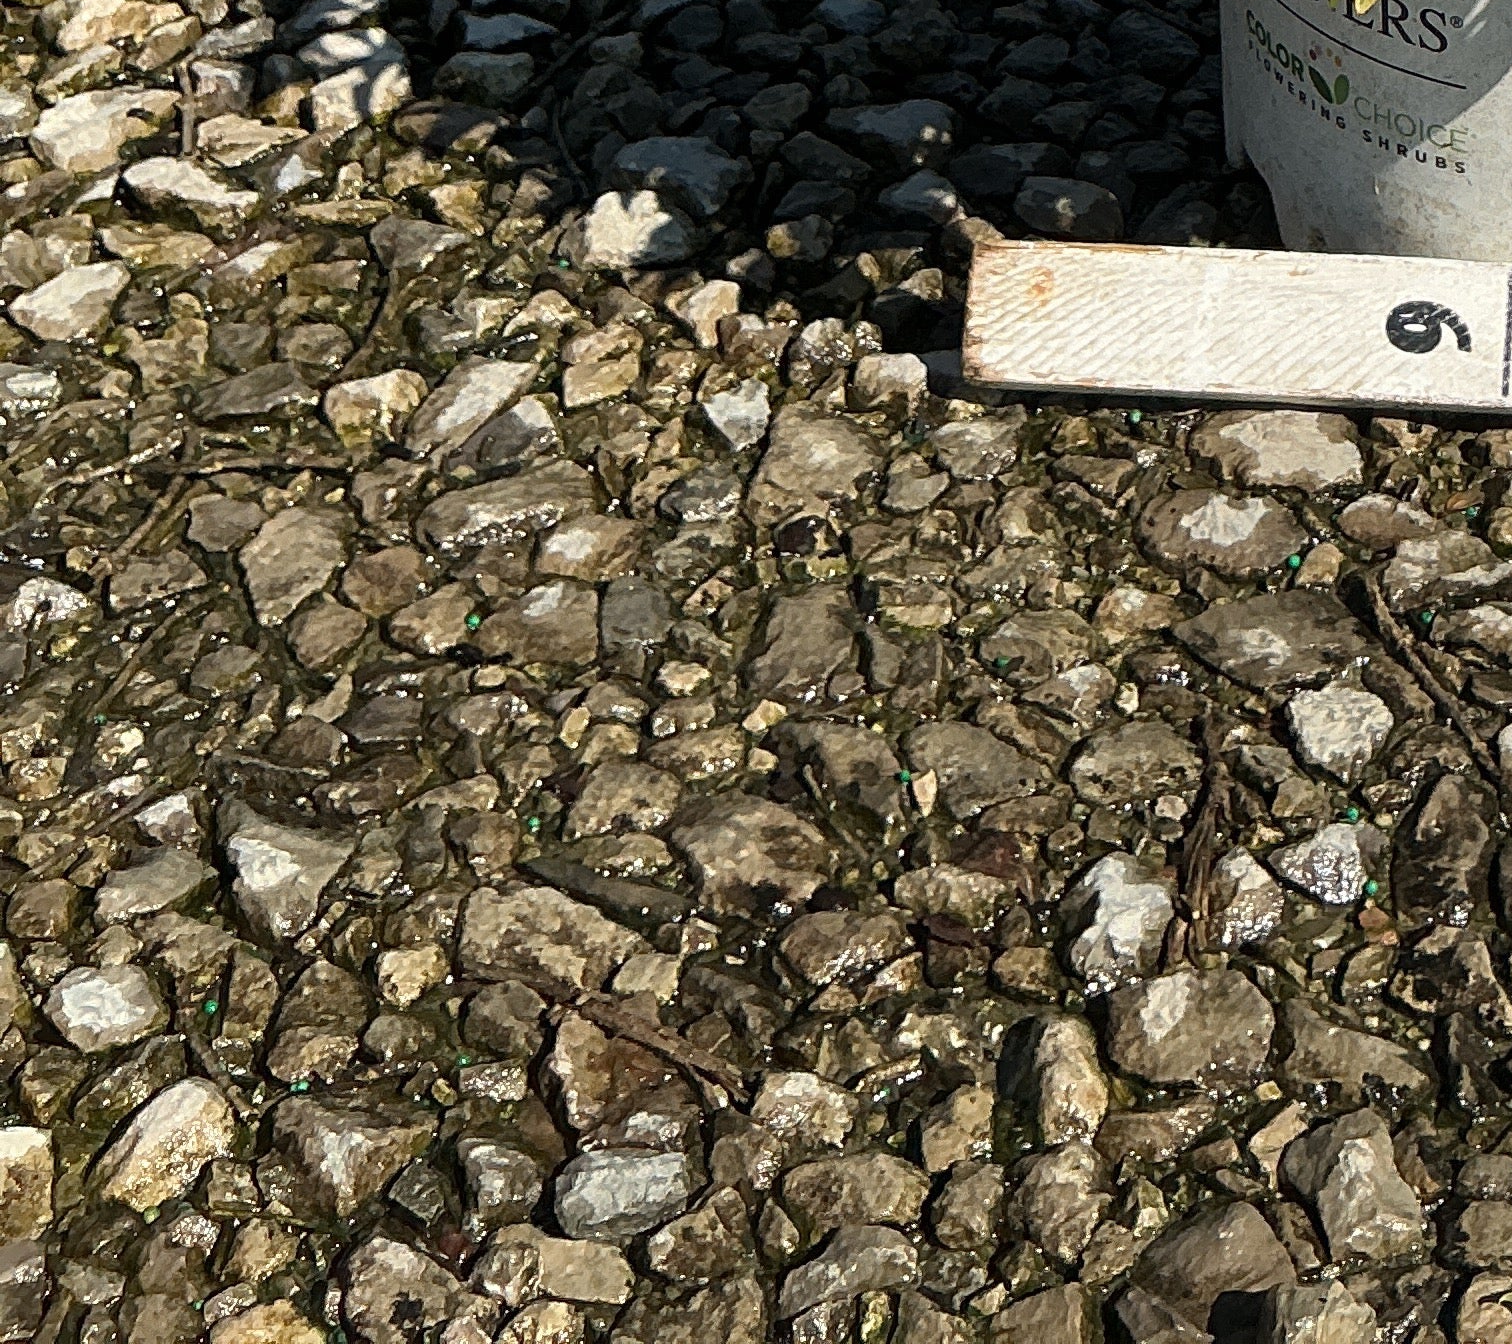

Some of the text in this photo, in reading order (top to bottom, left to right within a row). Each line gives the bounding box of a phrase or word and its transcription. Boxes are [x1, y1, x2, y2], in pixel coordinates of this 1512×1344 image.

[1245, 9, 1469, 154] COLOR CHOICE
[1248, 39, 1467, 174] FLOWERING SHRUBS
